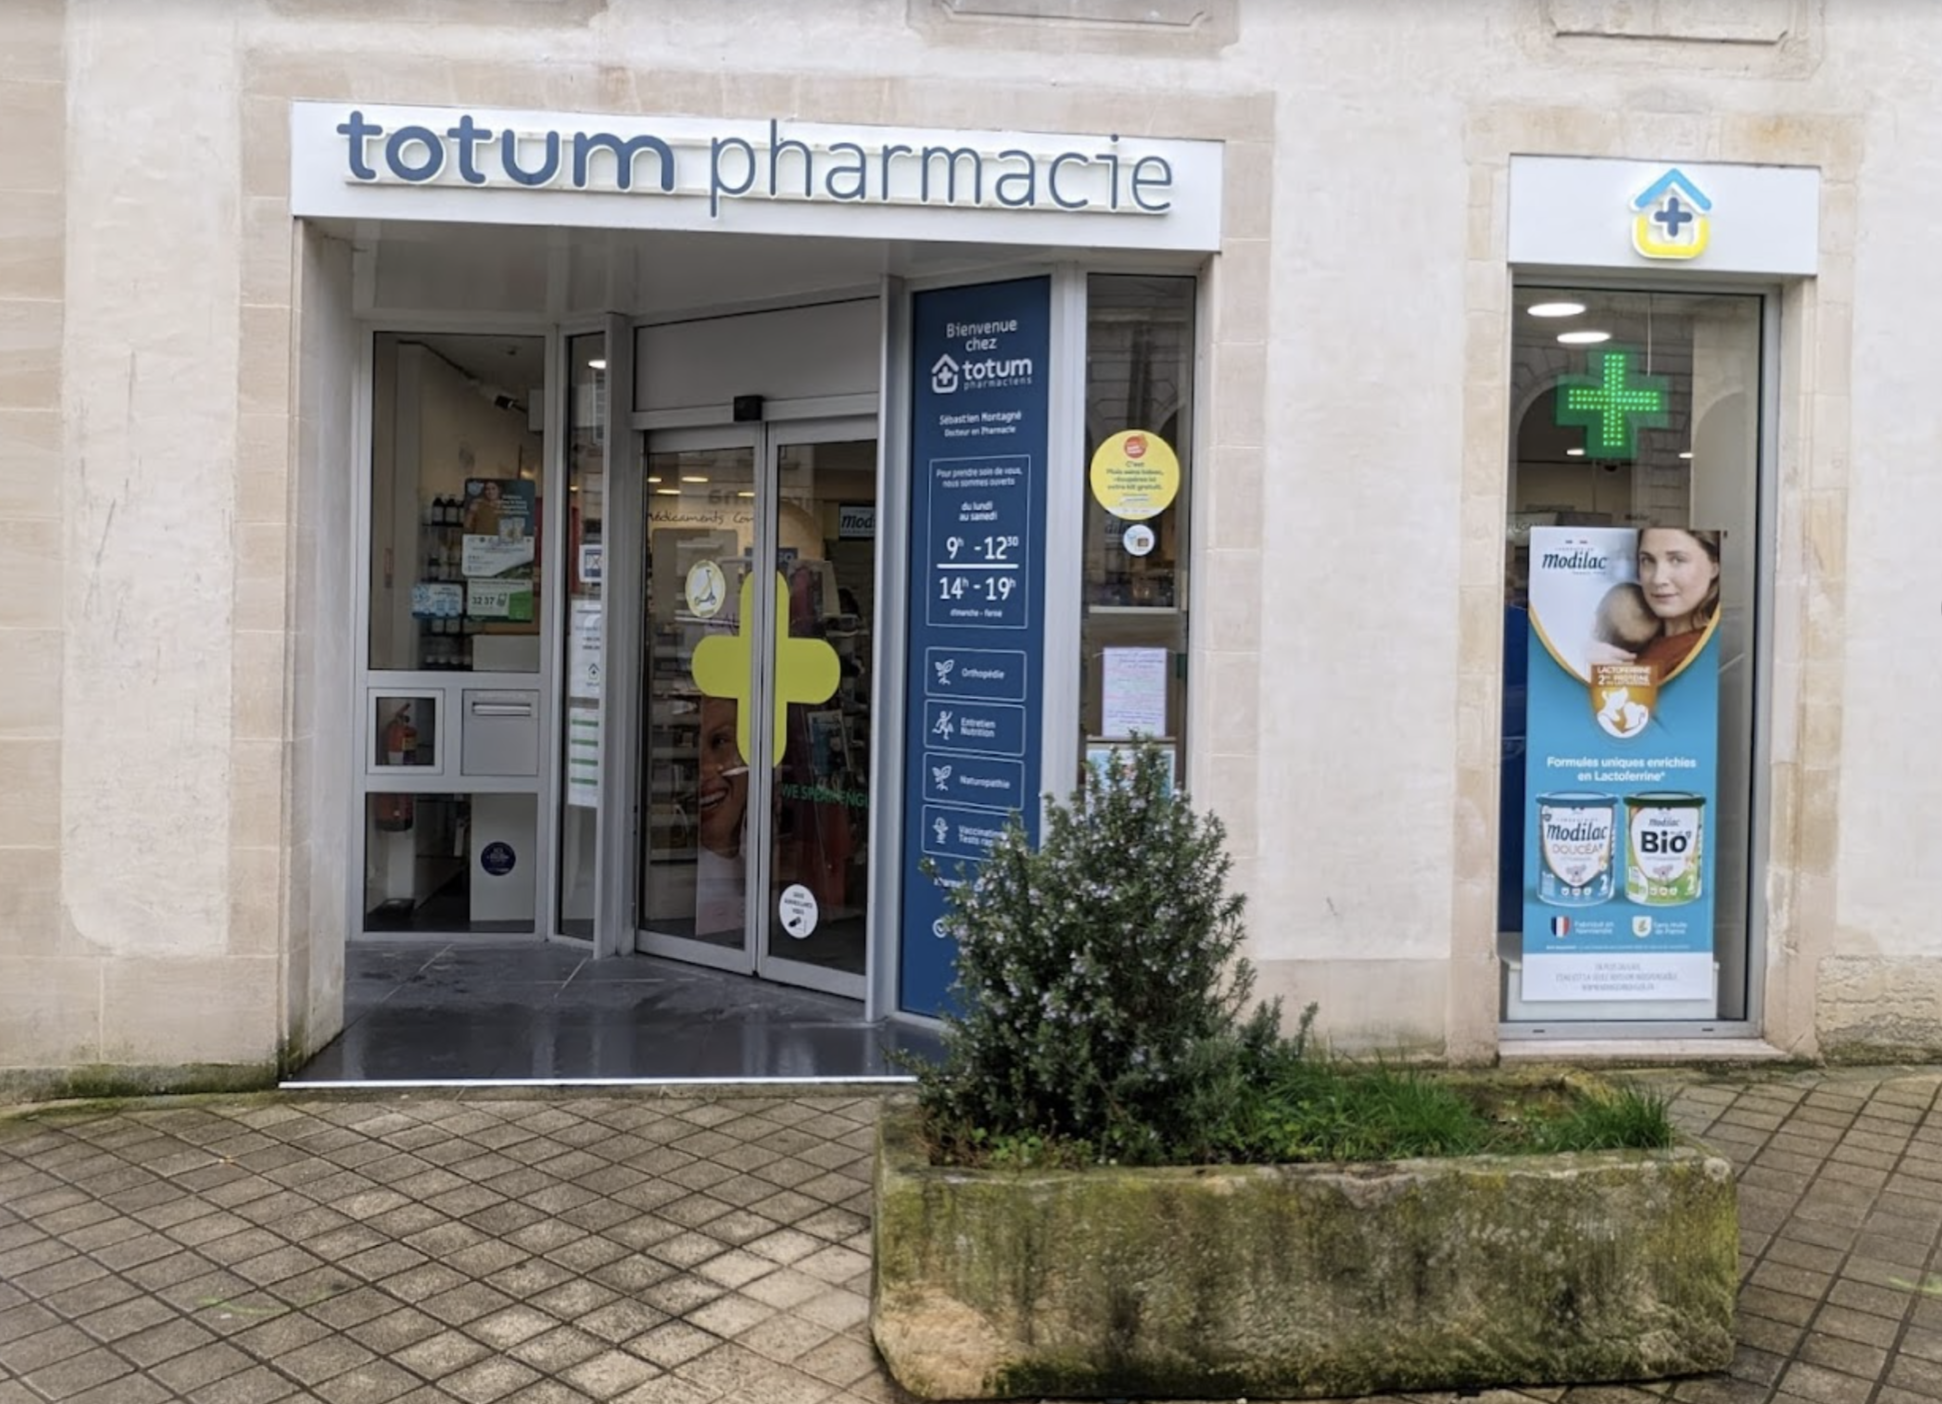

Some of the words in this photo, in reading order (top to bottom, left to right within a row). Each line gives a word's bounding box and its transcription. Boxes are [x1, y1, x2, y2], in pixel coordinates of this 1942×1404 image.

[336, 109, 676, 193] totum
[708, 116, 1174, 218] pharmacie
[946, 319, 1018, 338] Bienvenue
[965, 337, 998, 352] chez
[962, 358, 1033, 380] totum
[964, 377, 1032, 391] pharmaciens
[981, 425, 1016, 435] Pharmacie
[1541, 551, 1608, 569] Modilac
[939, 577, 969, 599] 14h
[985, 577, 1016, 600] 19h
[961, 668, 1005, 680] Orthopédie
[960, 718, 996, 729] Entretien
[960, 727, 995, 738] Nutrition
[1547, 757, 1599, 768] Formules
[1601, 757, 1645, 771] uniques
[1647, 757, 1696, 768] enrichies
[959, 776, 1011, 789] Naturopathie
[1577, 772, 1591, 782] en
[1547, 822, 1608, 842] Modilac
[1640, 830, 1688, 854] Bio
